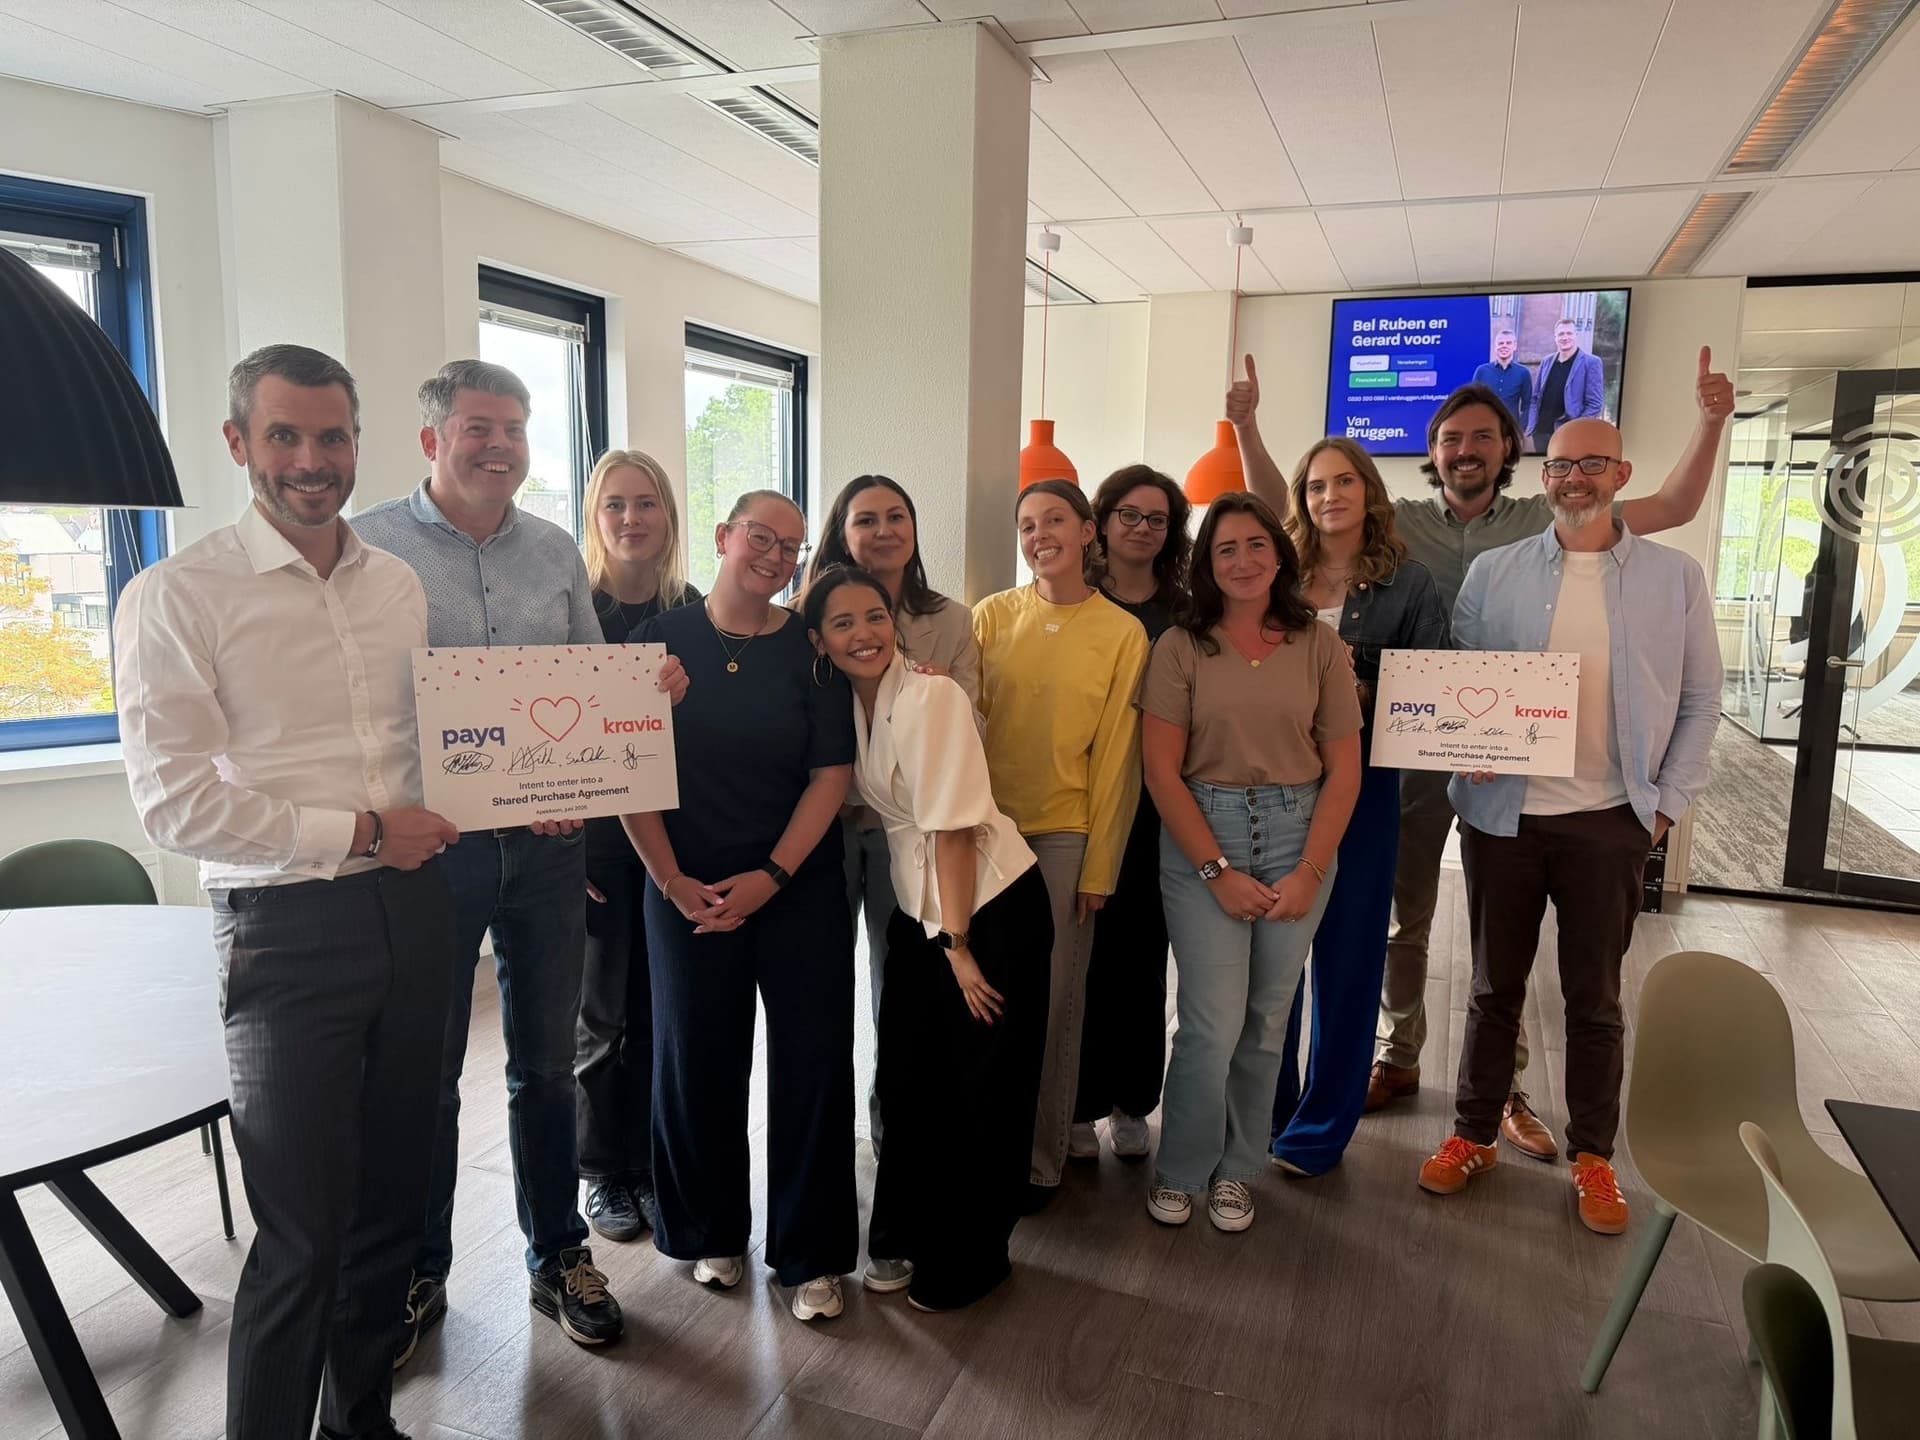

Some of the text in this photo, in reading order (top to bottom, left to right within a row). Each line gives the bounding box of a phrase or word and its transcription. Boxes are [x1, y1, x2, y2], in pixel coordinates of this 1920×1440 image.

[1352, 317, 1448, 332] Bel Ruben en
[1351, 333, 1442, 347] Gerard voor:
[1346, 415, 1371, 426] Van
[1345, 427, 1409, 441] Bruggen.
[1389, 701, 1436, 717] payq
[442, 726, 506, 750] payq
[1418, 749, 1530, 762] Shared Purchase Agreement
[519, 781, 544, 790] Intent
[546, 780, 555, 788] to
[557, 779, 579, 787] enter
[580, 776, 597, 785] into
[491, 786, 630, 807] Shared Purchase Agreement
